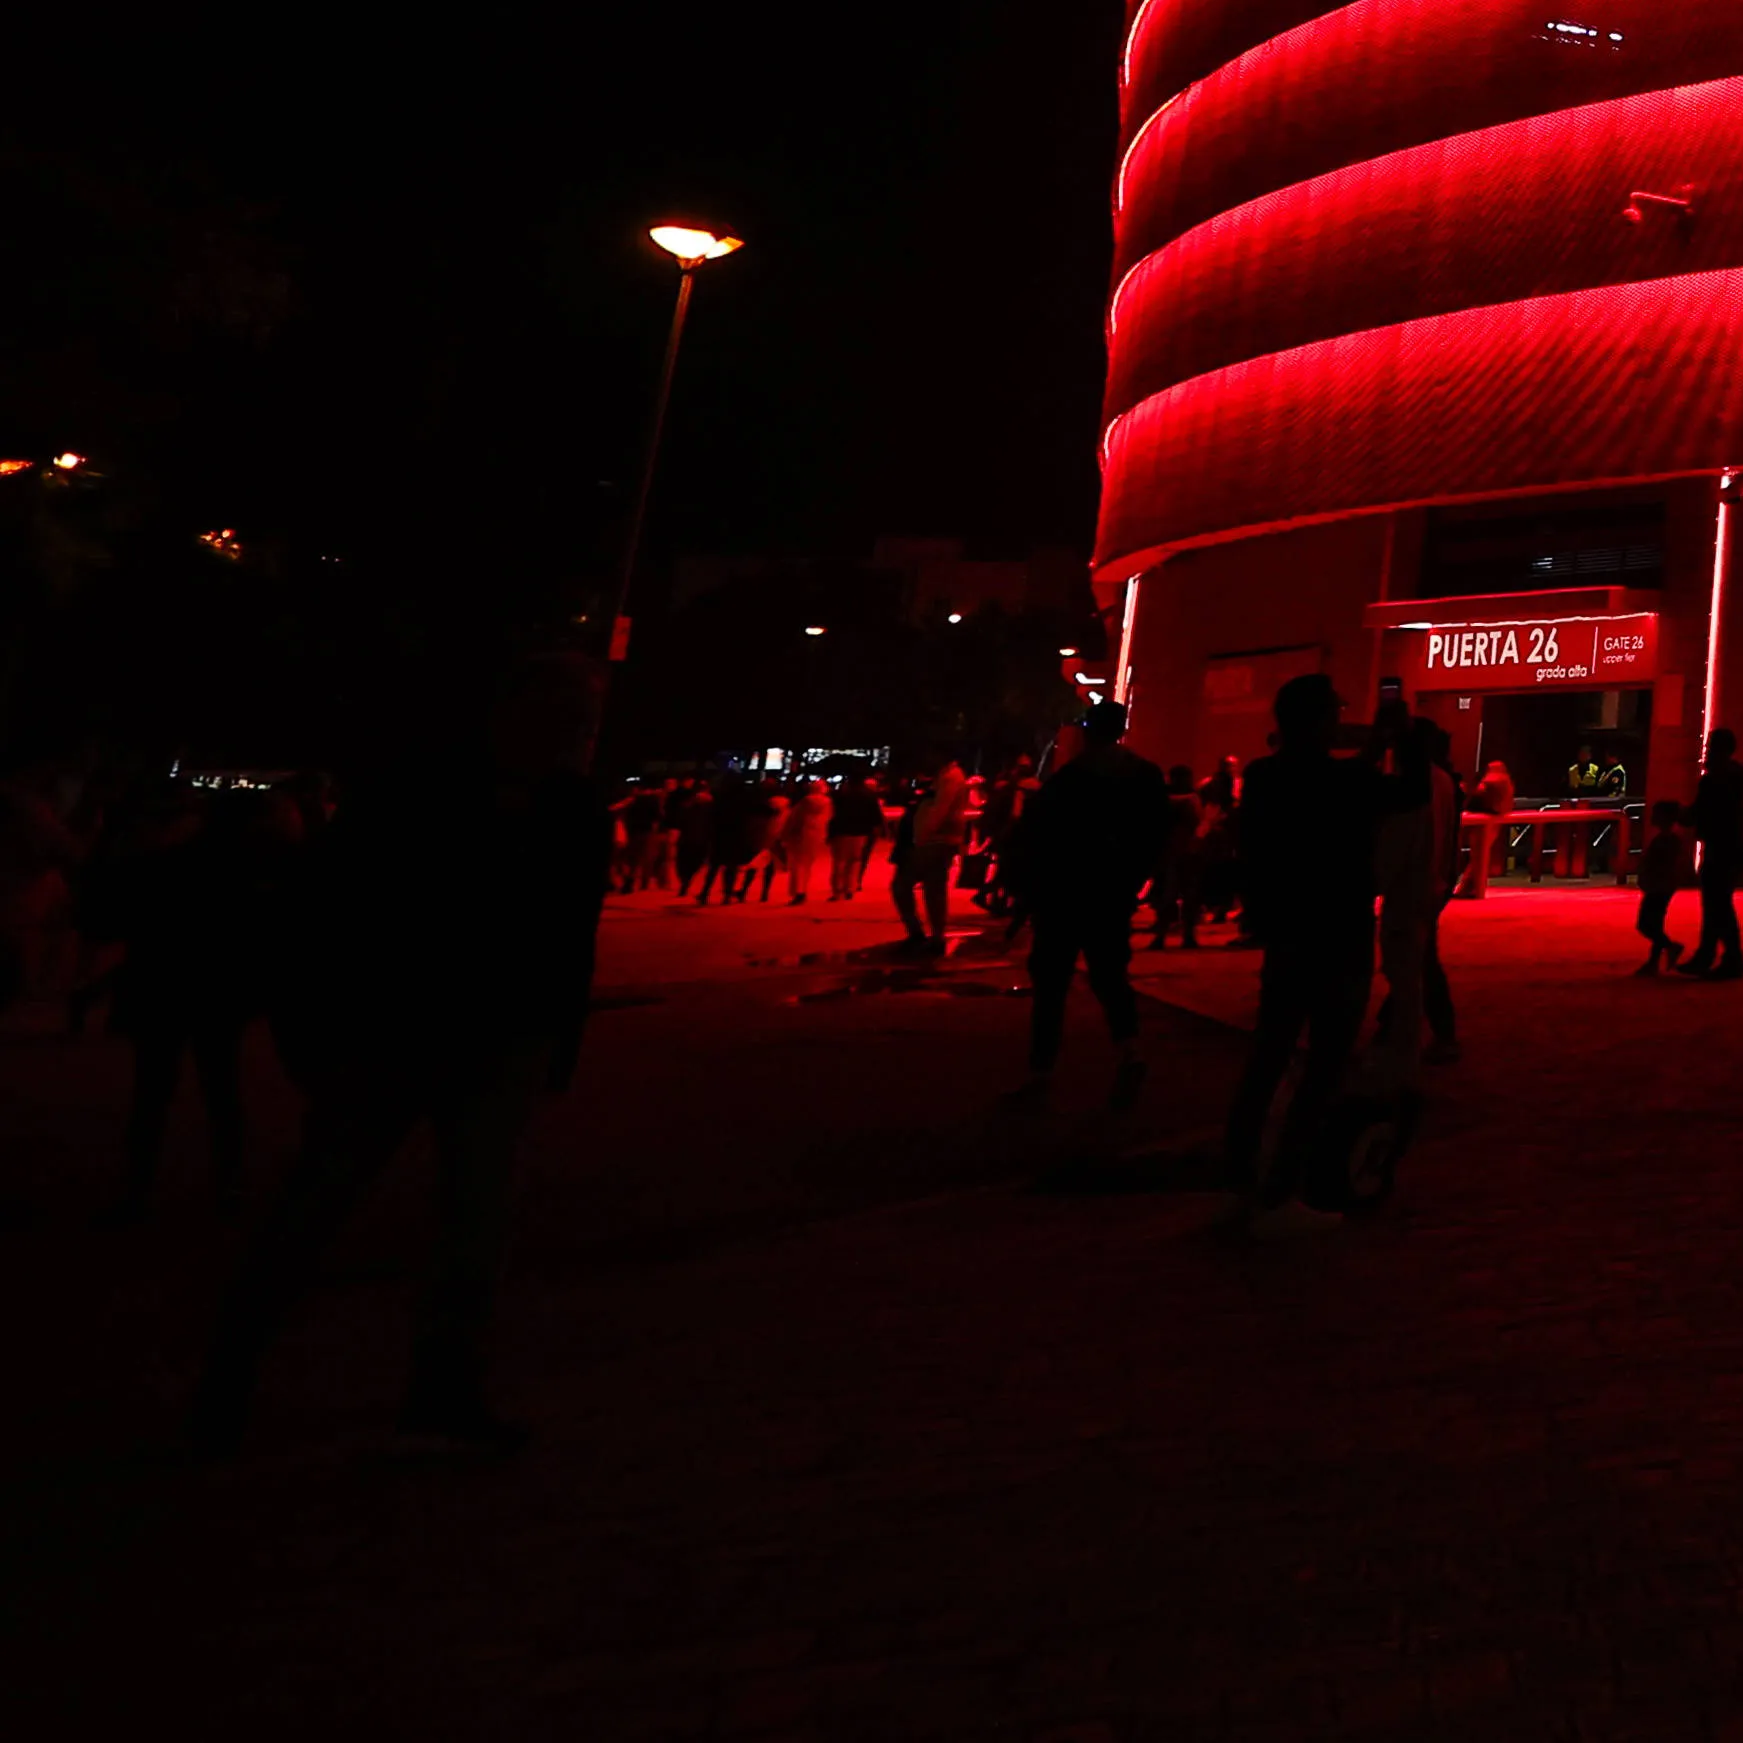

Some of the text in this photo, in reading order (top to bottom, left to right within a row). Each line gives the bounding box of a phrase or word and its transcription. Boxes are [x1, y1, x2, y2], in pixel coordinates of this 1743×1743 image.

[1427, 627, 1559, 669] PUERTA 26
[1603, 635, 1645, 651] GATE 26
[1536, 664, 1588, 682] grada alta
